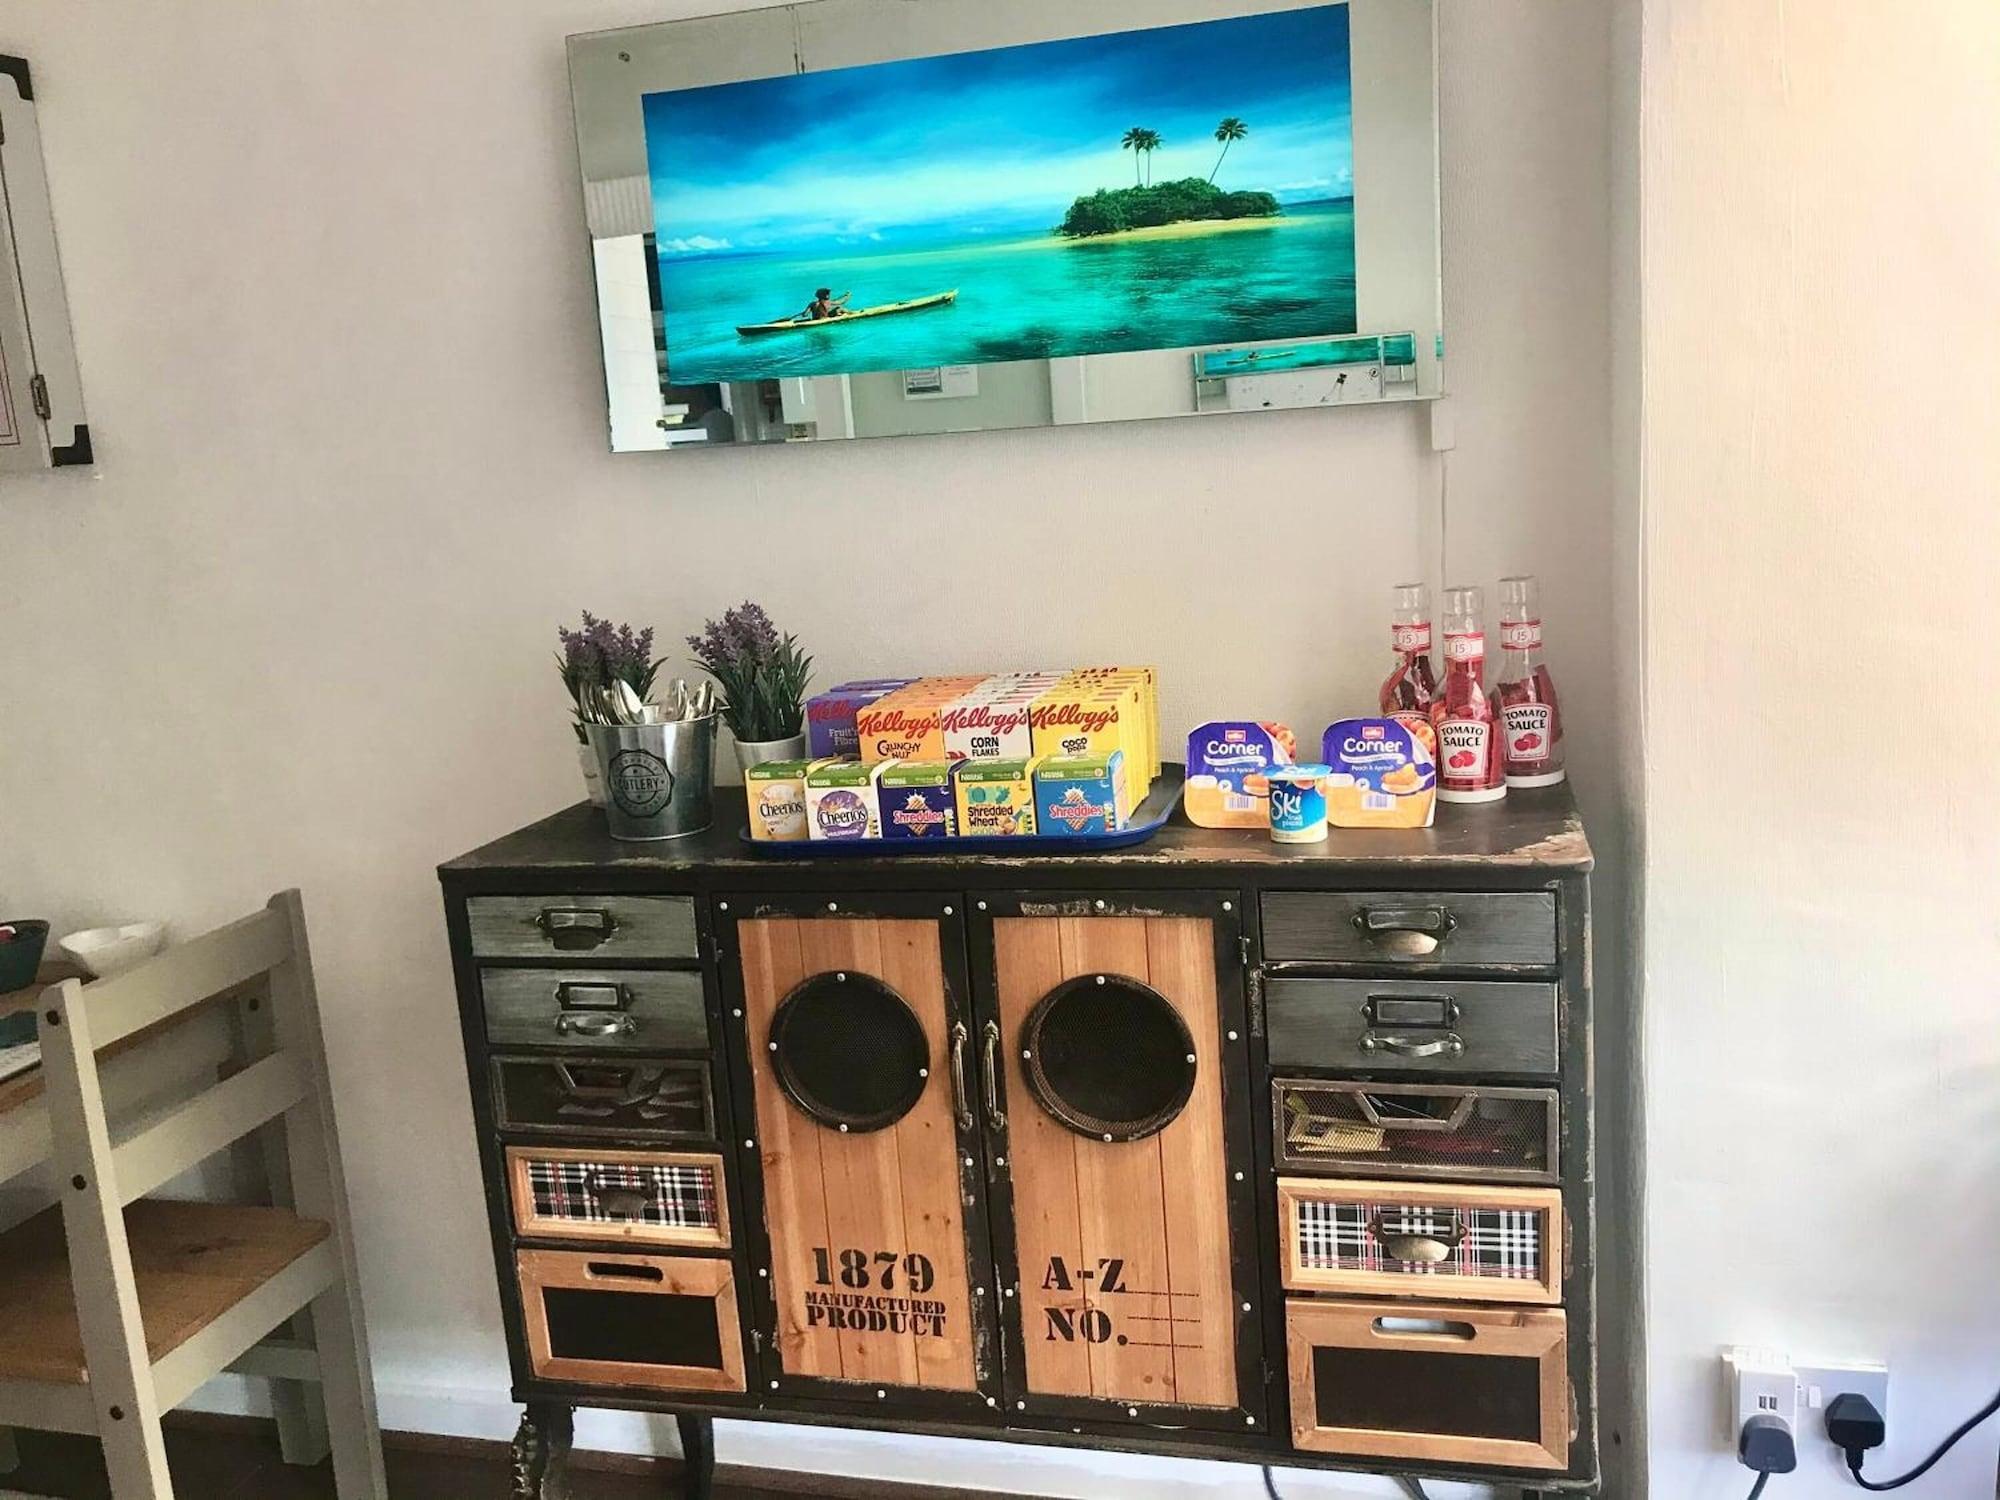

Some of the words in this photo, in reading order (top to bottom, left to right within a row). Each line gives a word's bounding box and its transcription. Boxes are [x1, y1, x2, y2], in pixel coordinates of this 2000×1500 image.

[943, 706, 1028, 735] Kellogg's
[1031, 703, 1119, 733] Kellogg's
[1505, 710, 1548, 721] TOMATO
[859, 710, 940, 739] Kellogg's
[1441, 726, 1484, 736] TOMATO
[1508, 718, 1546, 731] SAUCE
[877, 739, 921, 756] CRUNCHY
[970, 736, 999, 749] CORN
[1207, 740, 1264, 755] Corner
[1343, 737, 1403, 753] Corner
[1443, 736, 1481, 747] SAUCE
[972, 748, 1000, 757] FLAKES
[760, 802, 803, 818] Cheerios
[967, 804, 1012, 816] Shredded
[1049, 803, 1105, 819] Shreddies
[1271, 788, 1302, 820] Ski
[819, 808, 866, 826] Cheerios
[893, 809, 945, 824] Shreddies
[968, 816, 999, 827] Wheat
[812, 1247, 934, 1293] 1879
[1041, 1256, 1126, 1293] A-Z
[805, 1291, 946, 1314] MANUFACTURED
[807, 1305, 946, 1337] PRODUCT
[1044, 1307, 1128, 1346] NO.
